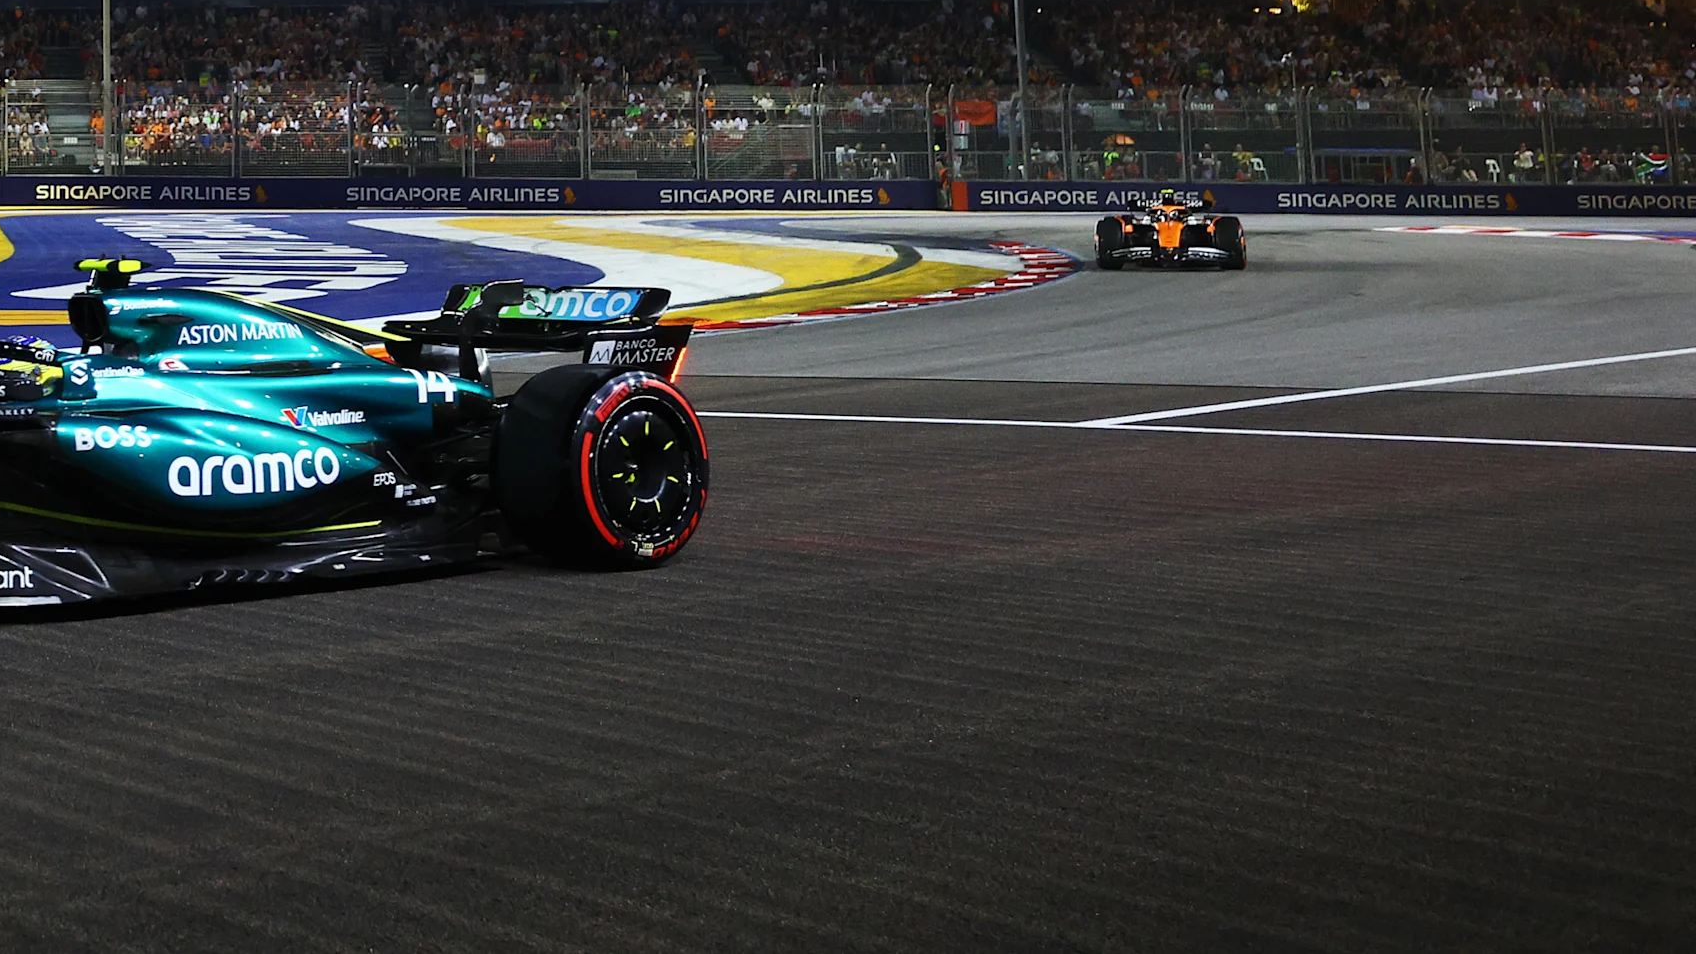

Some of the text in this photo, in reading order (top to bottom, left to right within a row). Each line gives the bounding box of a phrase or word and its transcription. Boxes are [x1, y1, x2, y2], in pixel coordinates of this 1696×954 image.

[36, 185, 251, 201] SINGAPORE AIRLINES
[346, 187, 560, 203] SINGAPORE AIRLINES
[659, 188, 874, 204] SINGAPORE AIRLINES
[980, 189, 1099, 205] SINGAPORE
[1277, 193, 1500, 209] SINGAPORE AIRLINES
[1577, 194, 1696, 210] SINGAPORE
[498, 289, 632, 318] amco
[178, 322, 304, 346] ASTON MARTIN
[616, 338, 657, 351] BANCO
[34, 349, 55, 362] citi
[612, 346, 676, 365] MASTER
[402, 368, 457, 403] 14
[74, 425, 152, 452] BOSS
[168, 447, 341, 497] aramco
[374, 472, 396, 486] EPOS
